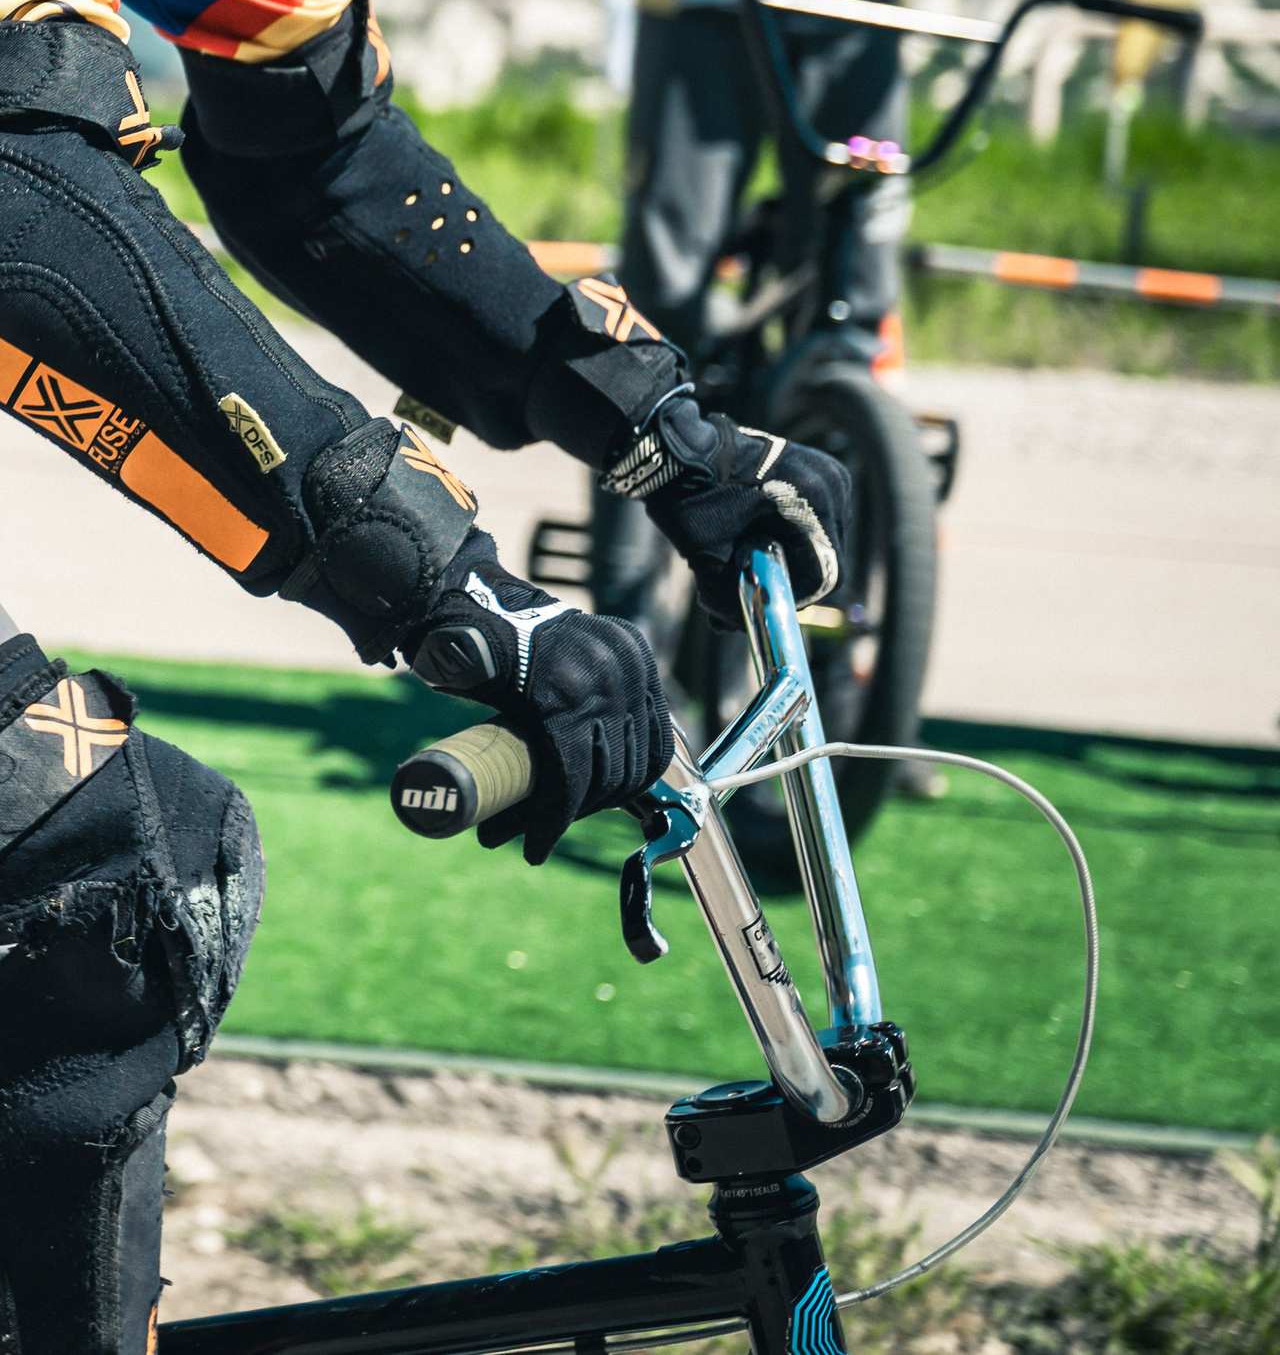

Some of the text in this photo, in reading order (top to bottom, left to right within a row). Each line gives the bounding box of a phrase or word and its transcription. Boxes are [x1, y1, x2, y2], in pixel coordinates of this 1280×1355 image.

[87, 407, 141, 471] FUSE
[243, 426, 275, 465] DFS
[400, 785, 458, 812] odi
